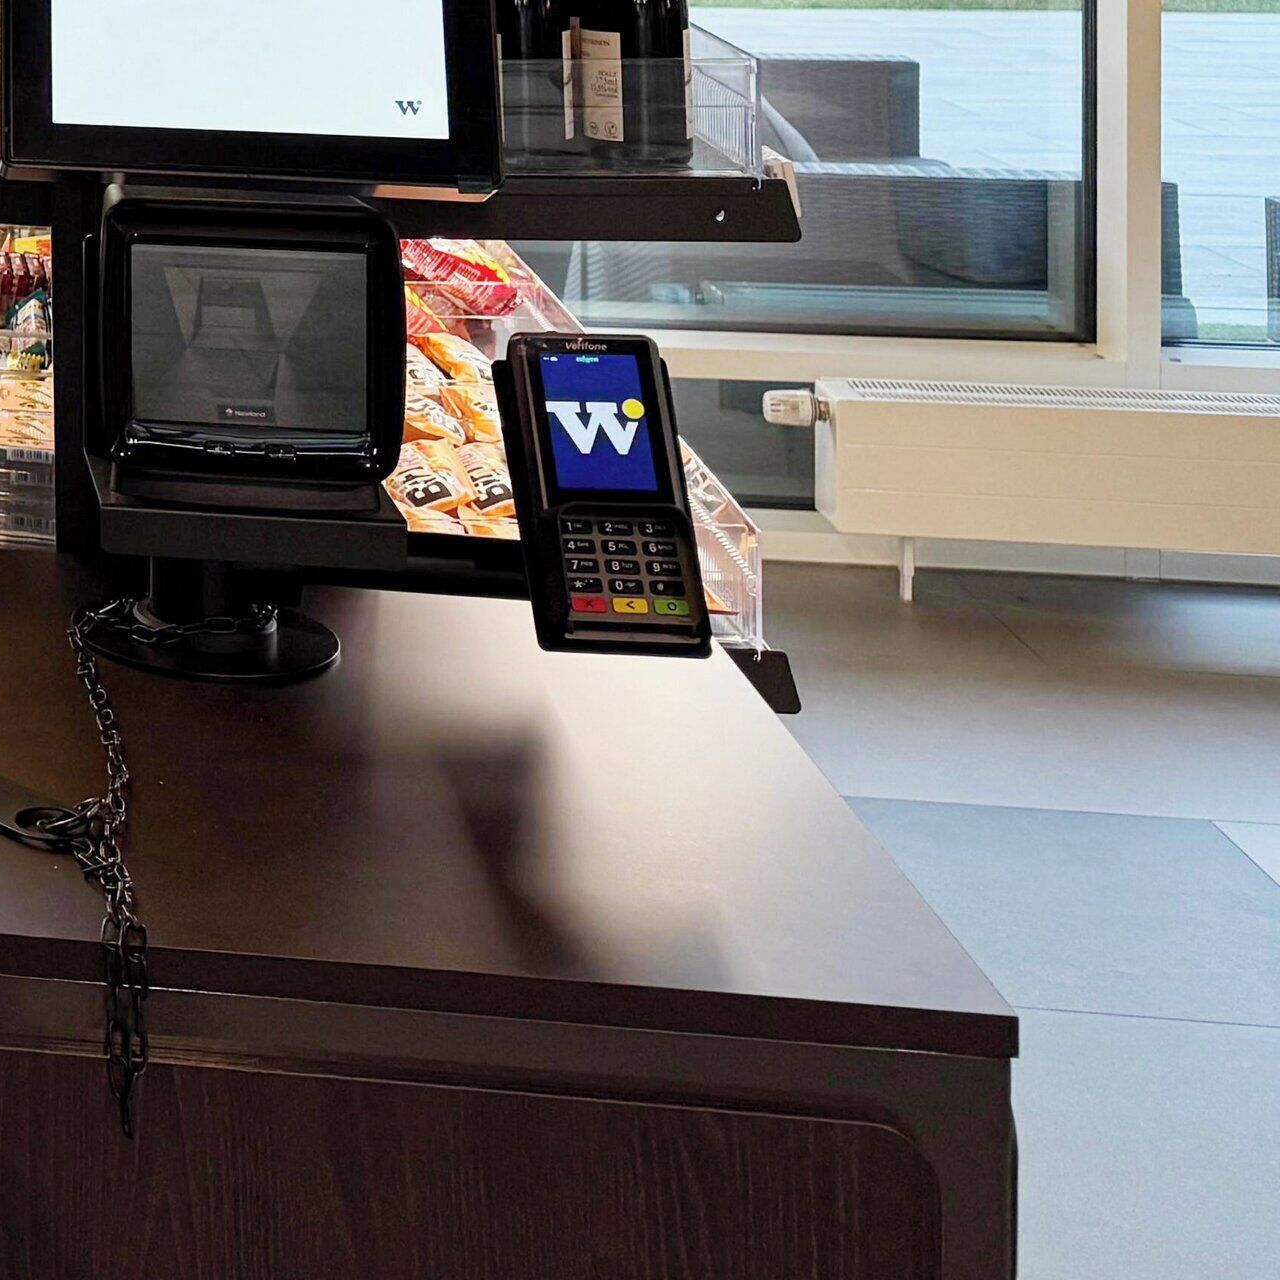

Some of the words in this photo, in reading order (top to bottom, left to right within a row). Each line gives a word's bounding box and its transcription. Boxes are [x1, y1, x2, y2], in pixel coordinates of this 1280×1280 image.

[565, 341, 608, 352] Verifone
[566, 521, 572, 531] 1
[605, 522, 613, 532] 2
[645, 524, 653, 533] 3
[567, 540, 575, 550] 4
[608, 541, 616, 551] 5
[649, 543, 657, 552] 6
[571, 560, 578, 570] 7
[611, 561, 620, 571] 8
[652, 562, 660, 572] 9
[615, 580, 623, 590] 0
